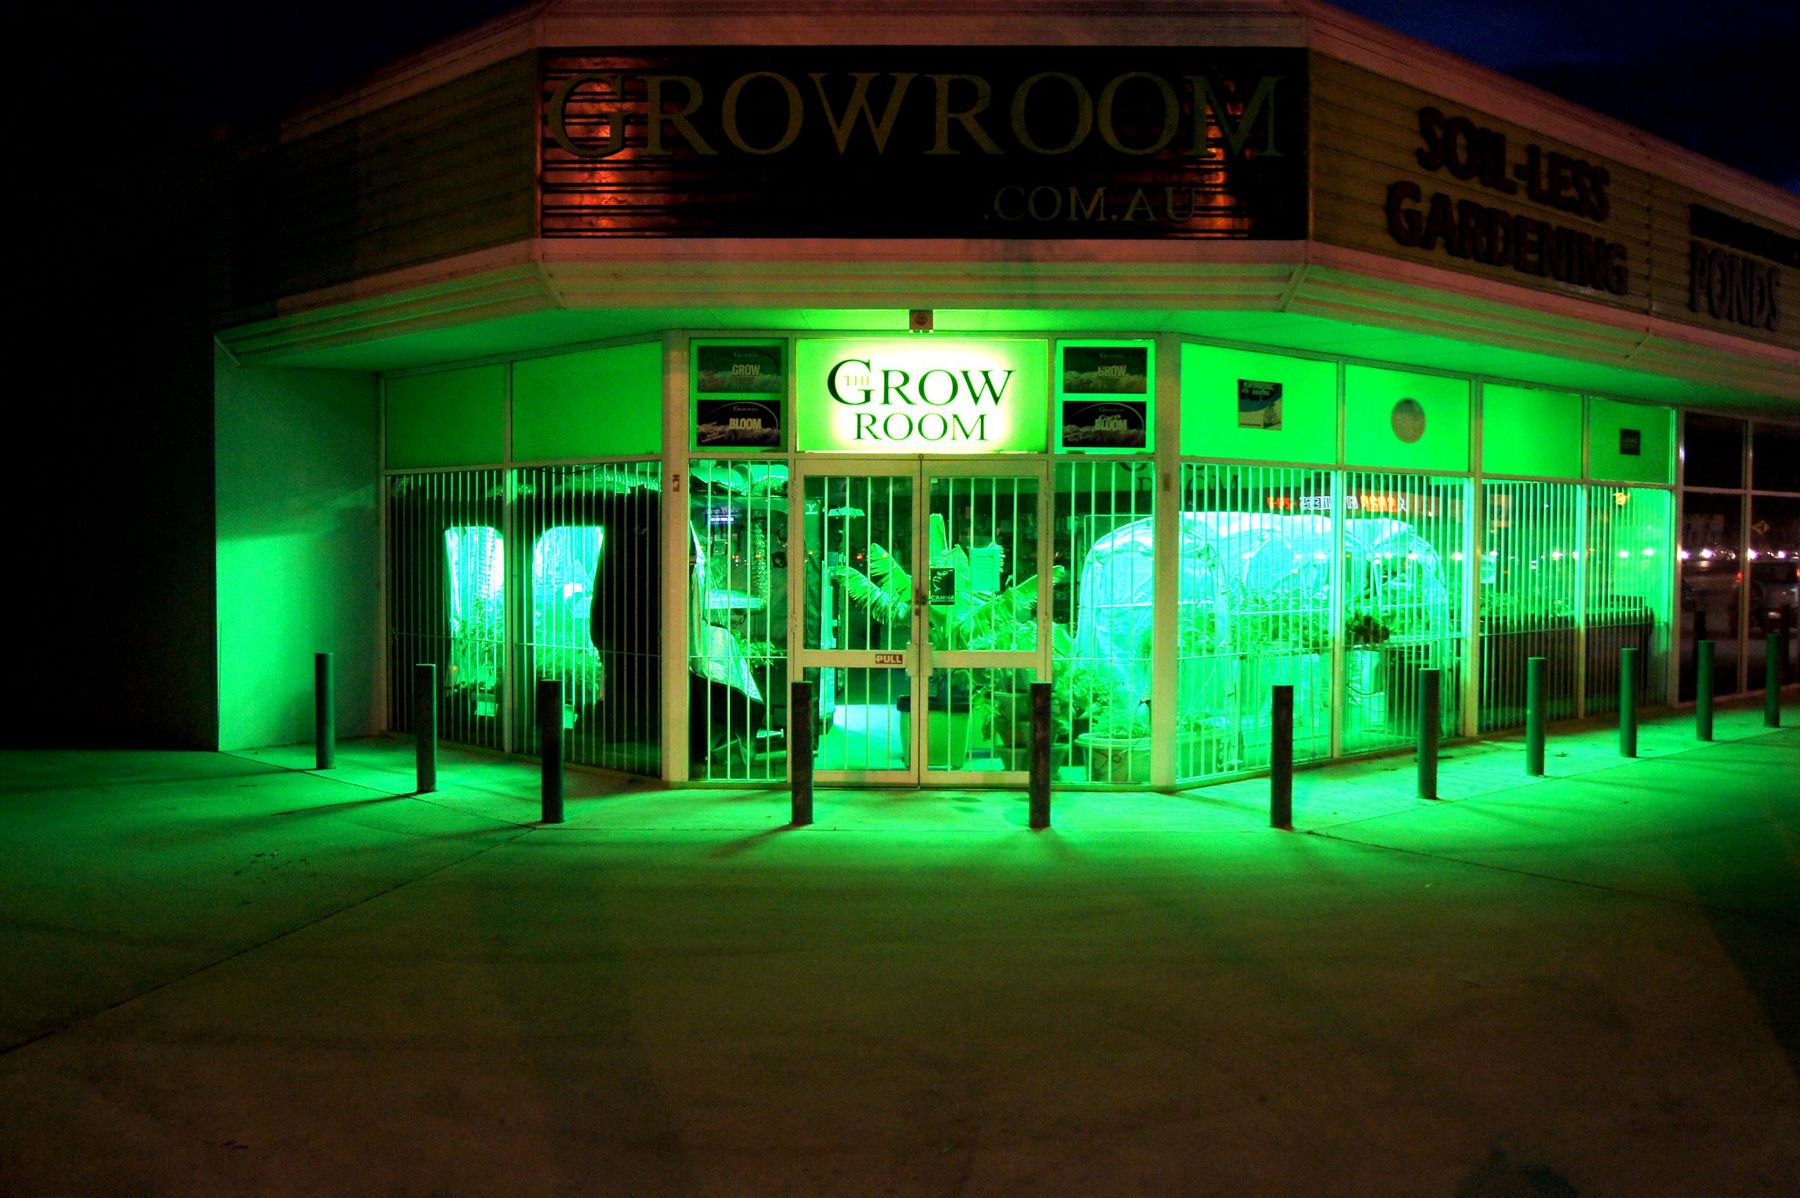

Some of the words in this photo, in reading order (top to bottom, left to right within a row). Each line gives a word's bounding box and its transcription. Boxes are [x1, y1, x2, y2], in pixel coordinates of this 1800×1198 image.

[547, 70, 1288, 159] GROWROOM
[1415, 105, 1611, 222] SOIL-LESS
[1385, 180, 1629, 296] GARDENING
[1688, 240, 1781, 332] PONDS
[732, 364, 761, 376] GROW
[827, 358, 1016, 406] GROW
[1098, 365, 1127, 377] GROW
[729, 417, 762, 430] BLOOM
[854, 412, 989, 441] ROOM
[1095, 418, 1128, 431] BLOOM
[876, 654, 902, 664] PULL
